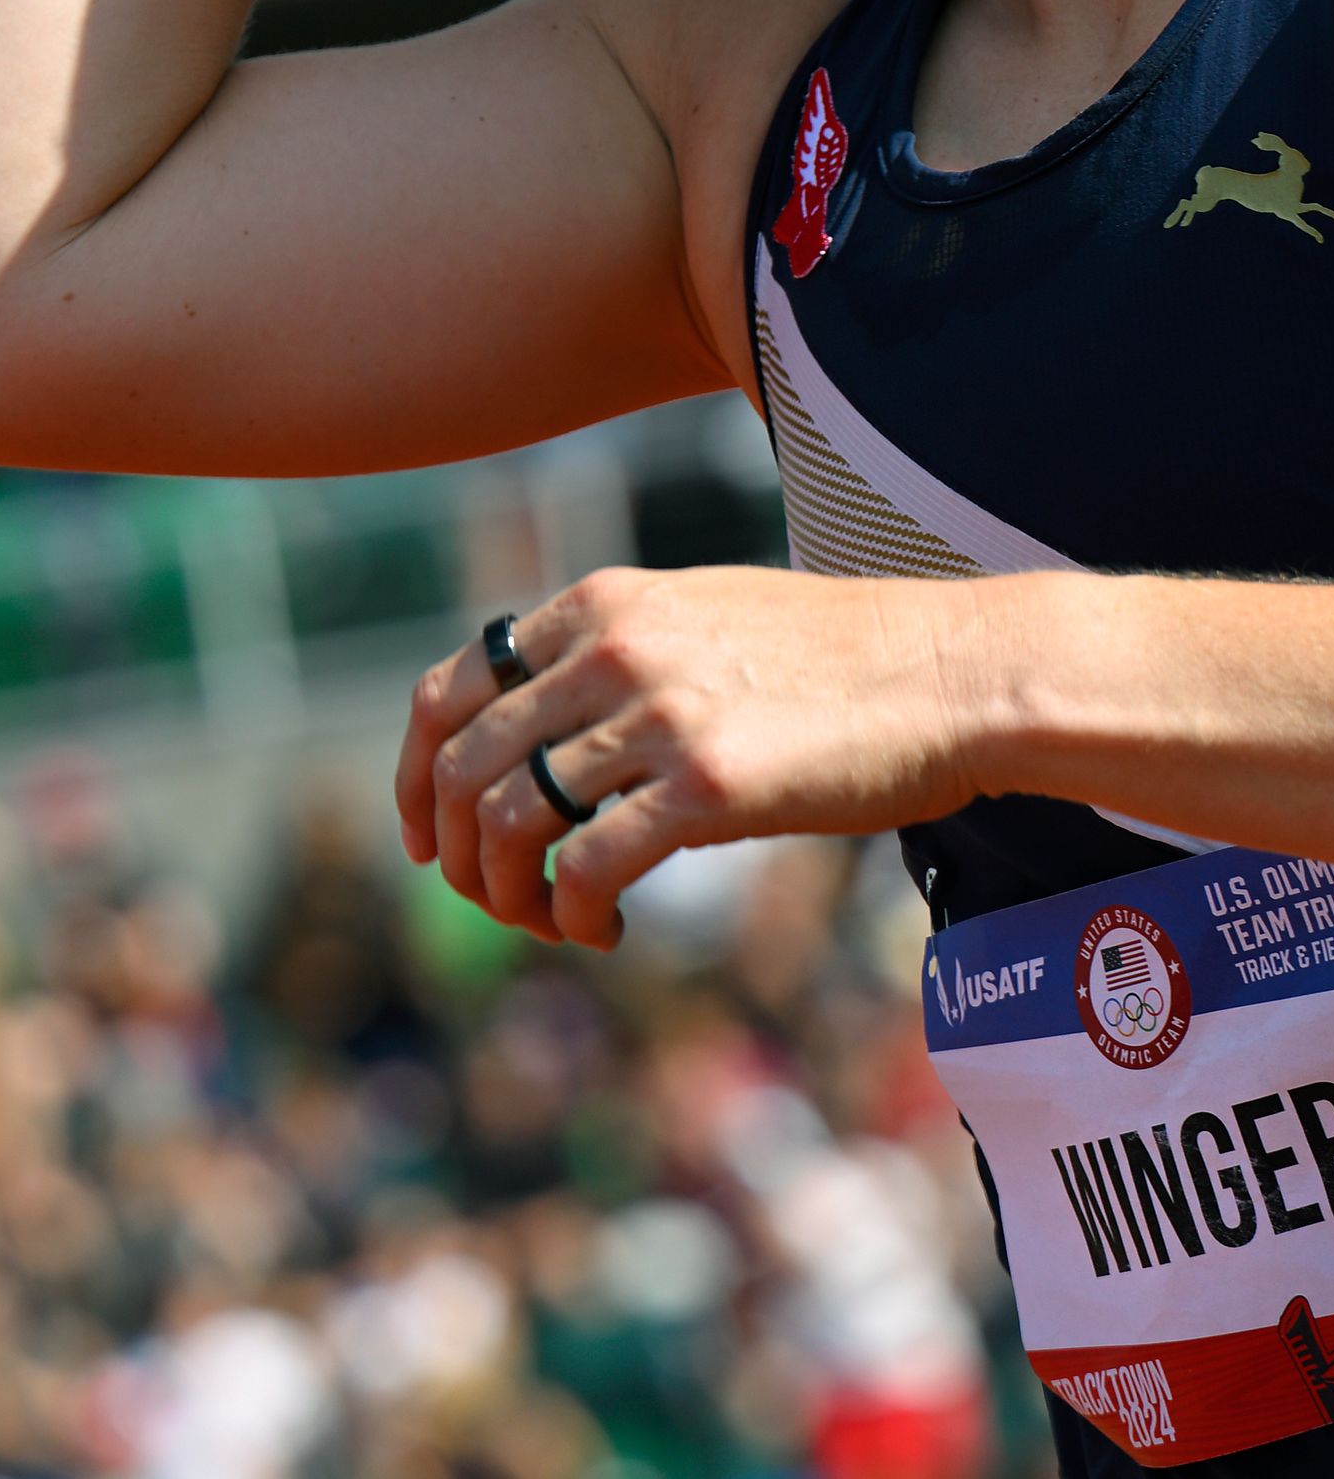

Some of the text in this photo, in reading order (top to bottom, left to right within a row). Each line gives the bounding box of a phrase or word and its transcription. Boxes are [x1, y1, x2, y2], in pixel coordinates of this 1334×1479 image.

[1203, 876, 1261, 917] U.S.
[1080, 909, 1161, 960] UNITED STATES
[1216, 907, 1296, 955] TEAM
[965, 956, 1045, 1008] USATF
[1235, 949, 1295, 985] TRACK
[1295, 945, 1310, 968] &
[1097, 1015, 1186, 1065] OLYMPIC TEAM
[1050, 1358, 1173, 1416] TRACKTOWN
[1119, 1397, 1176, 1449] 2024
